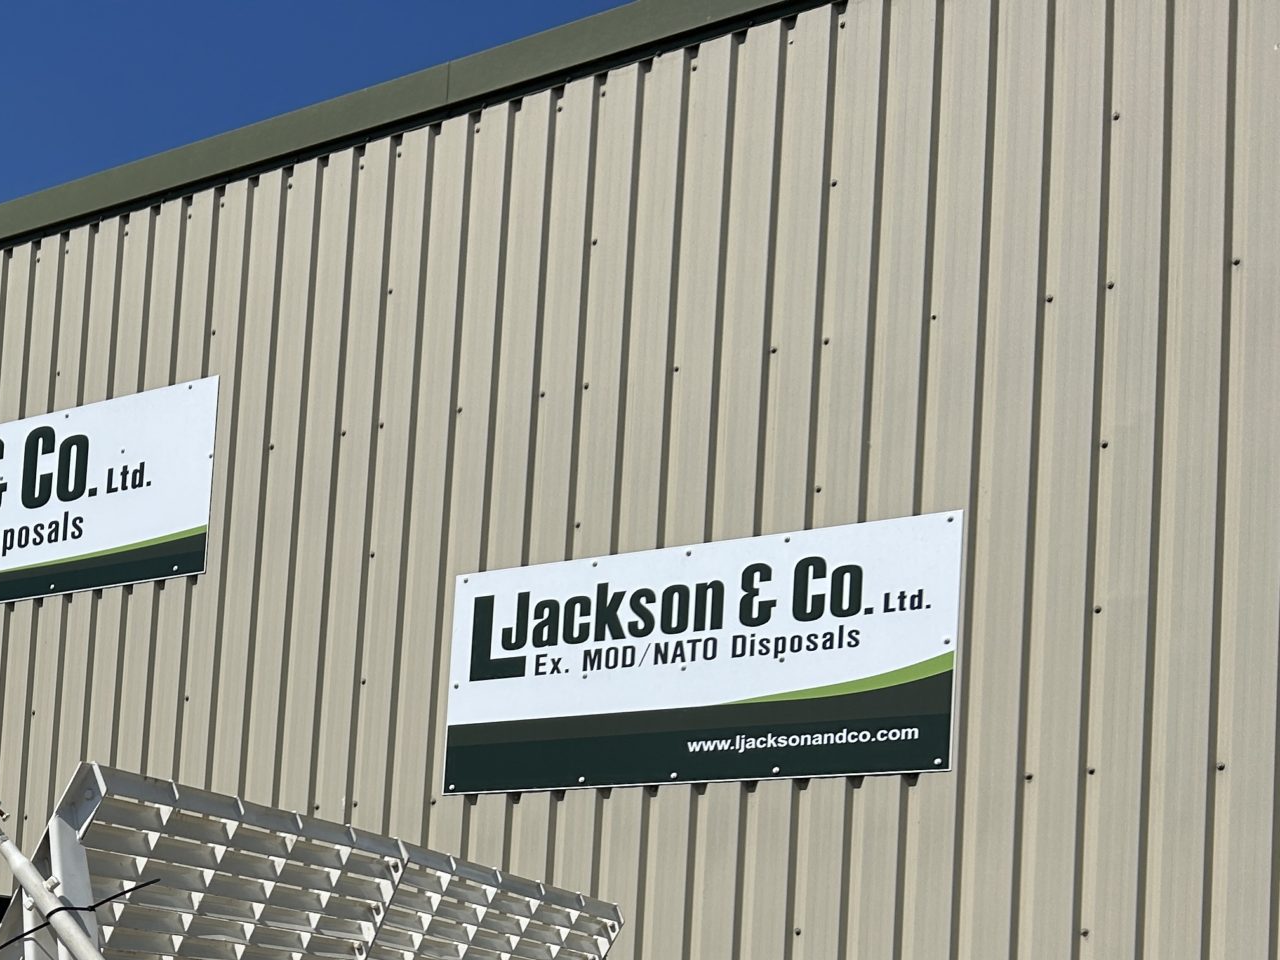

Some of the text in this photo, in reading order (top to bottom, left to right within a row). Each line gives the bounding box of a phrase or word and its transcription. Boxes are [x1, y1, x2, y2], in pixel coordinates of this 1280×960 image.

[21, 425, 98, 510] Co.
[106, 461, 152, 494] Ltd.
[738, 562, 777, 628] &
[792, 556, 874, 623] Co.
[883, 588, 931, 614] Ltd.
[534, 624, 861, 676] Ex. MOD/NATO Disposals
[687, 727, 919, 754] www.ljacksonandco.com
